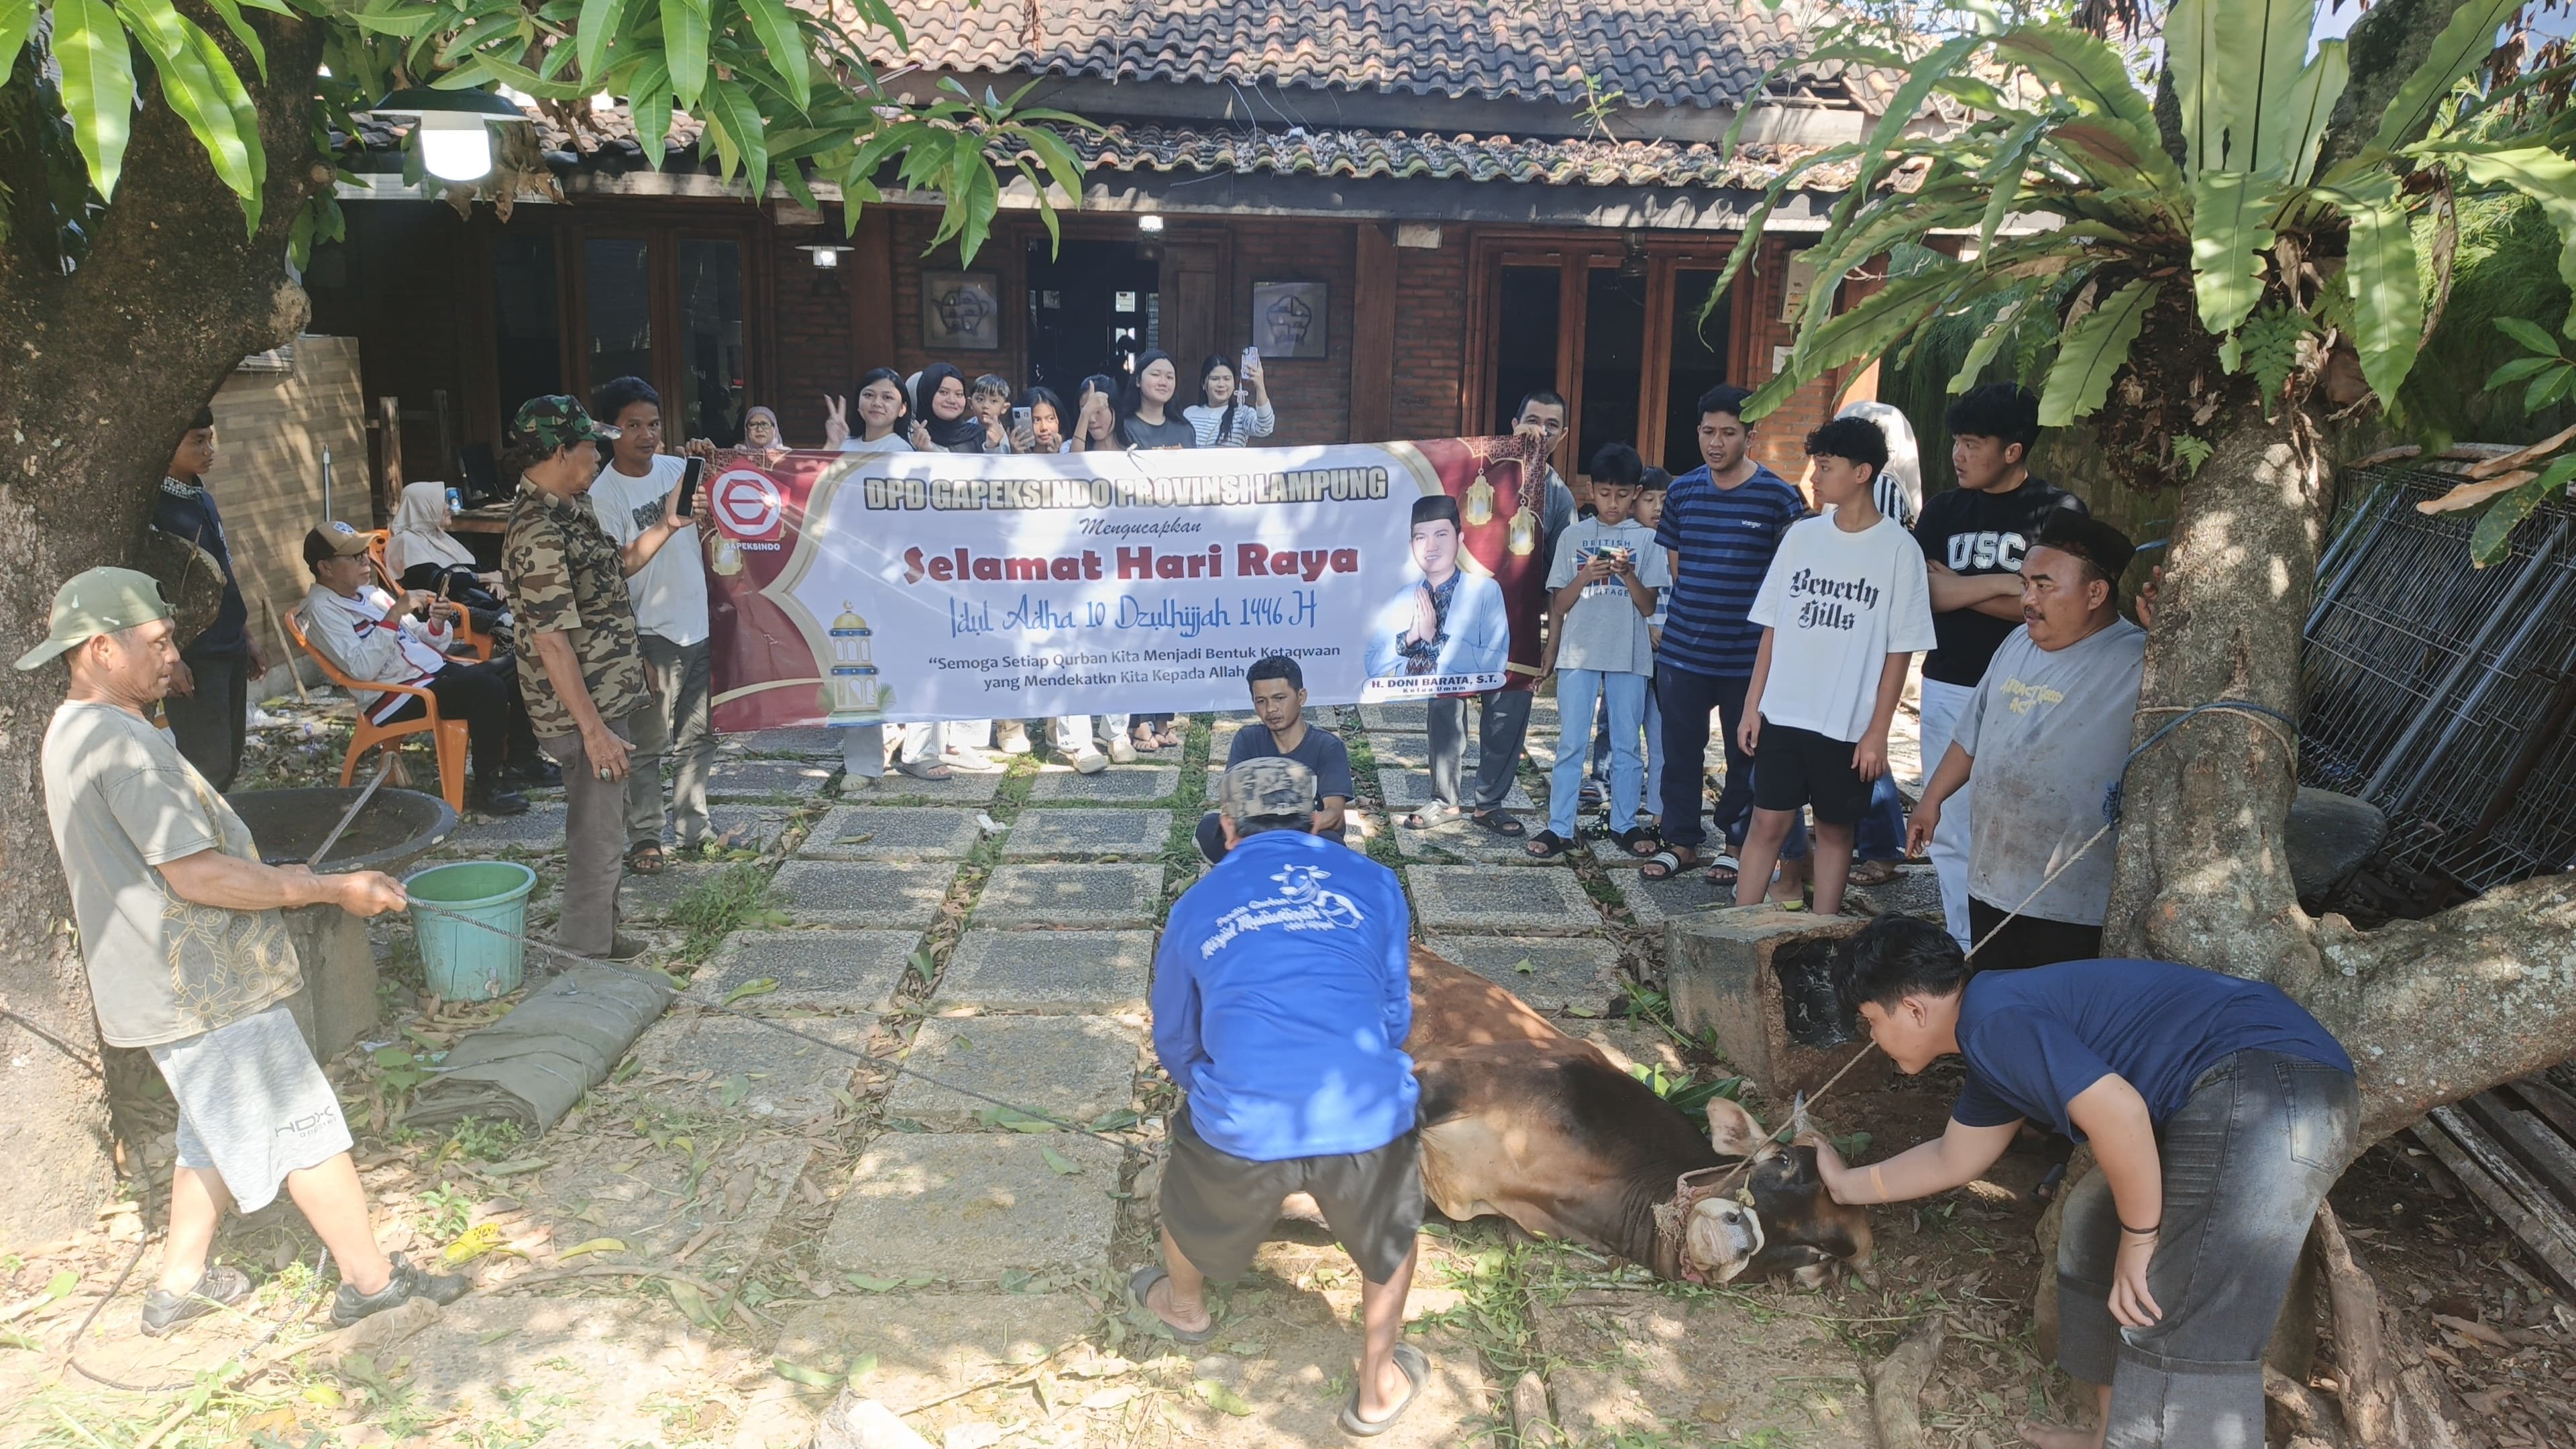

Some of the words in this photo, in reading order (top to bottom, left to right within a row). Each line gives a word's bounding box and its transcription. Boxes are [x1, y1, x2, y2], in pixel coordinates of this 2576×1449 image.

[864, 477, 926, 511] DPD
[930, 478, 1112, 511] GAPEKSINDO
[1116, 474, 1252, 508] PROVINSI
[1254, 466, 1389, 503] LAMPUNG
[1079, 517, 1202, 539] Mengucapkan
[724, 542, 781, 551] GAPEKSINDO
[1582, 539, 1631, 547] BRITISH
[1947, 531, 2026, 572] USC
[903, 546, 1102, 584] Selamat
[1117, 544, 1222, 580] Hari
[1237, 543, 1358, 582] Raya
[1790, 568, 1880, 611] Beverly
[950, 596, 994, 639] Idul
[1002, 593, 1075, 631] Adha
[1085, 600, 1106, 628] 10
[1114, 594, 1231, 638] Dzulhijjah
[1240, 596, 1283, 626] 1446
[1289, 590, 1318, 629] H
[1798, 600, 1856, 631] Hills
[1002, 655, 1049, 670] Setiap
[1053, 652, 1108, 669] Qurban
[1112, 650, 1140, 663] Kita
[1144, 647, 1201, 663] Menjadi
[1205, 647, 1256, 659] Bentuk
[1260, 646, 1341, 659] Ketaqwaan
[984, 677, 1020, 692] yang
[1024, 672, 1117, 687] Mendekatkn
[1120, 671, 1149, 684] Kita
[1152, 667, 1205, 684] Kepada
[1209, 665, 1245, 678] Allah
[1372, 680, 1383, 688] H.
[1387, 679, 1419, 688] DONI
[1422, 676, 1473, 686] BARATA,
[1477, 674, 1497, 684] S.T.
